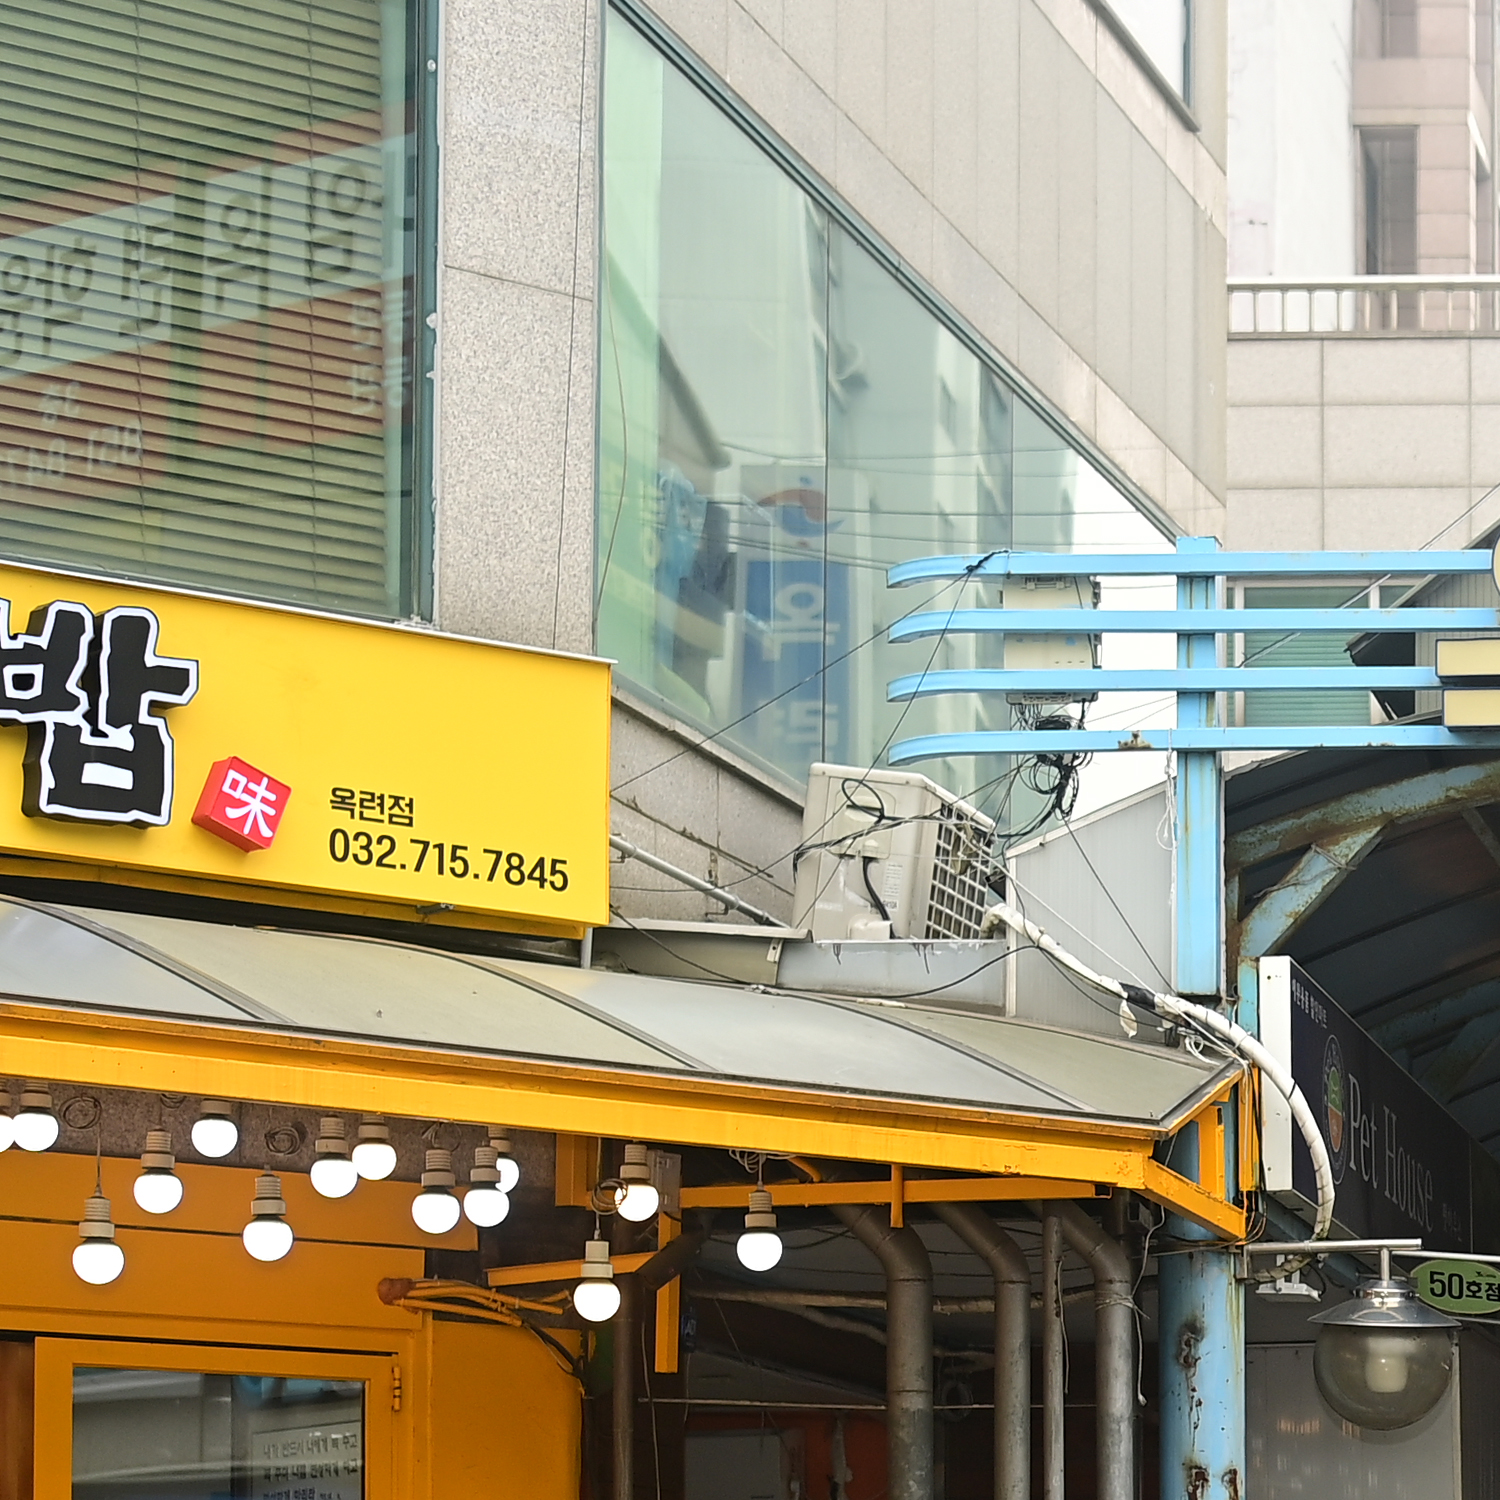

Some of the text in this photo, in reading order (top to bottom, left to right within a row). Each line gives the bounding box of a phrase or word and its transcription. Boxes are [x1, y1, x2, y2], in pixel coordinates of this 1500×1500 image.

[222, 774, 282, 842] 味
[329, 786, 415, 828] 옥련점
[328, 829, 571, 894] 032.715.7845
[1348, 1072, 1379, 1190] Pet
[1383, 1104, 1435, 1233] House
